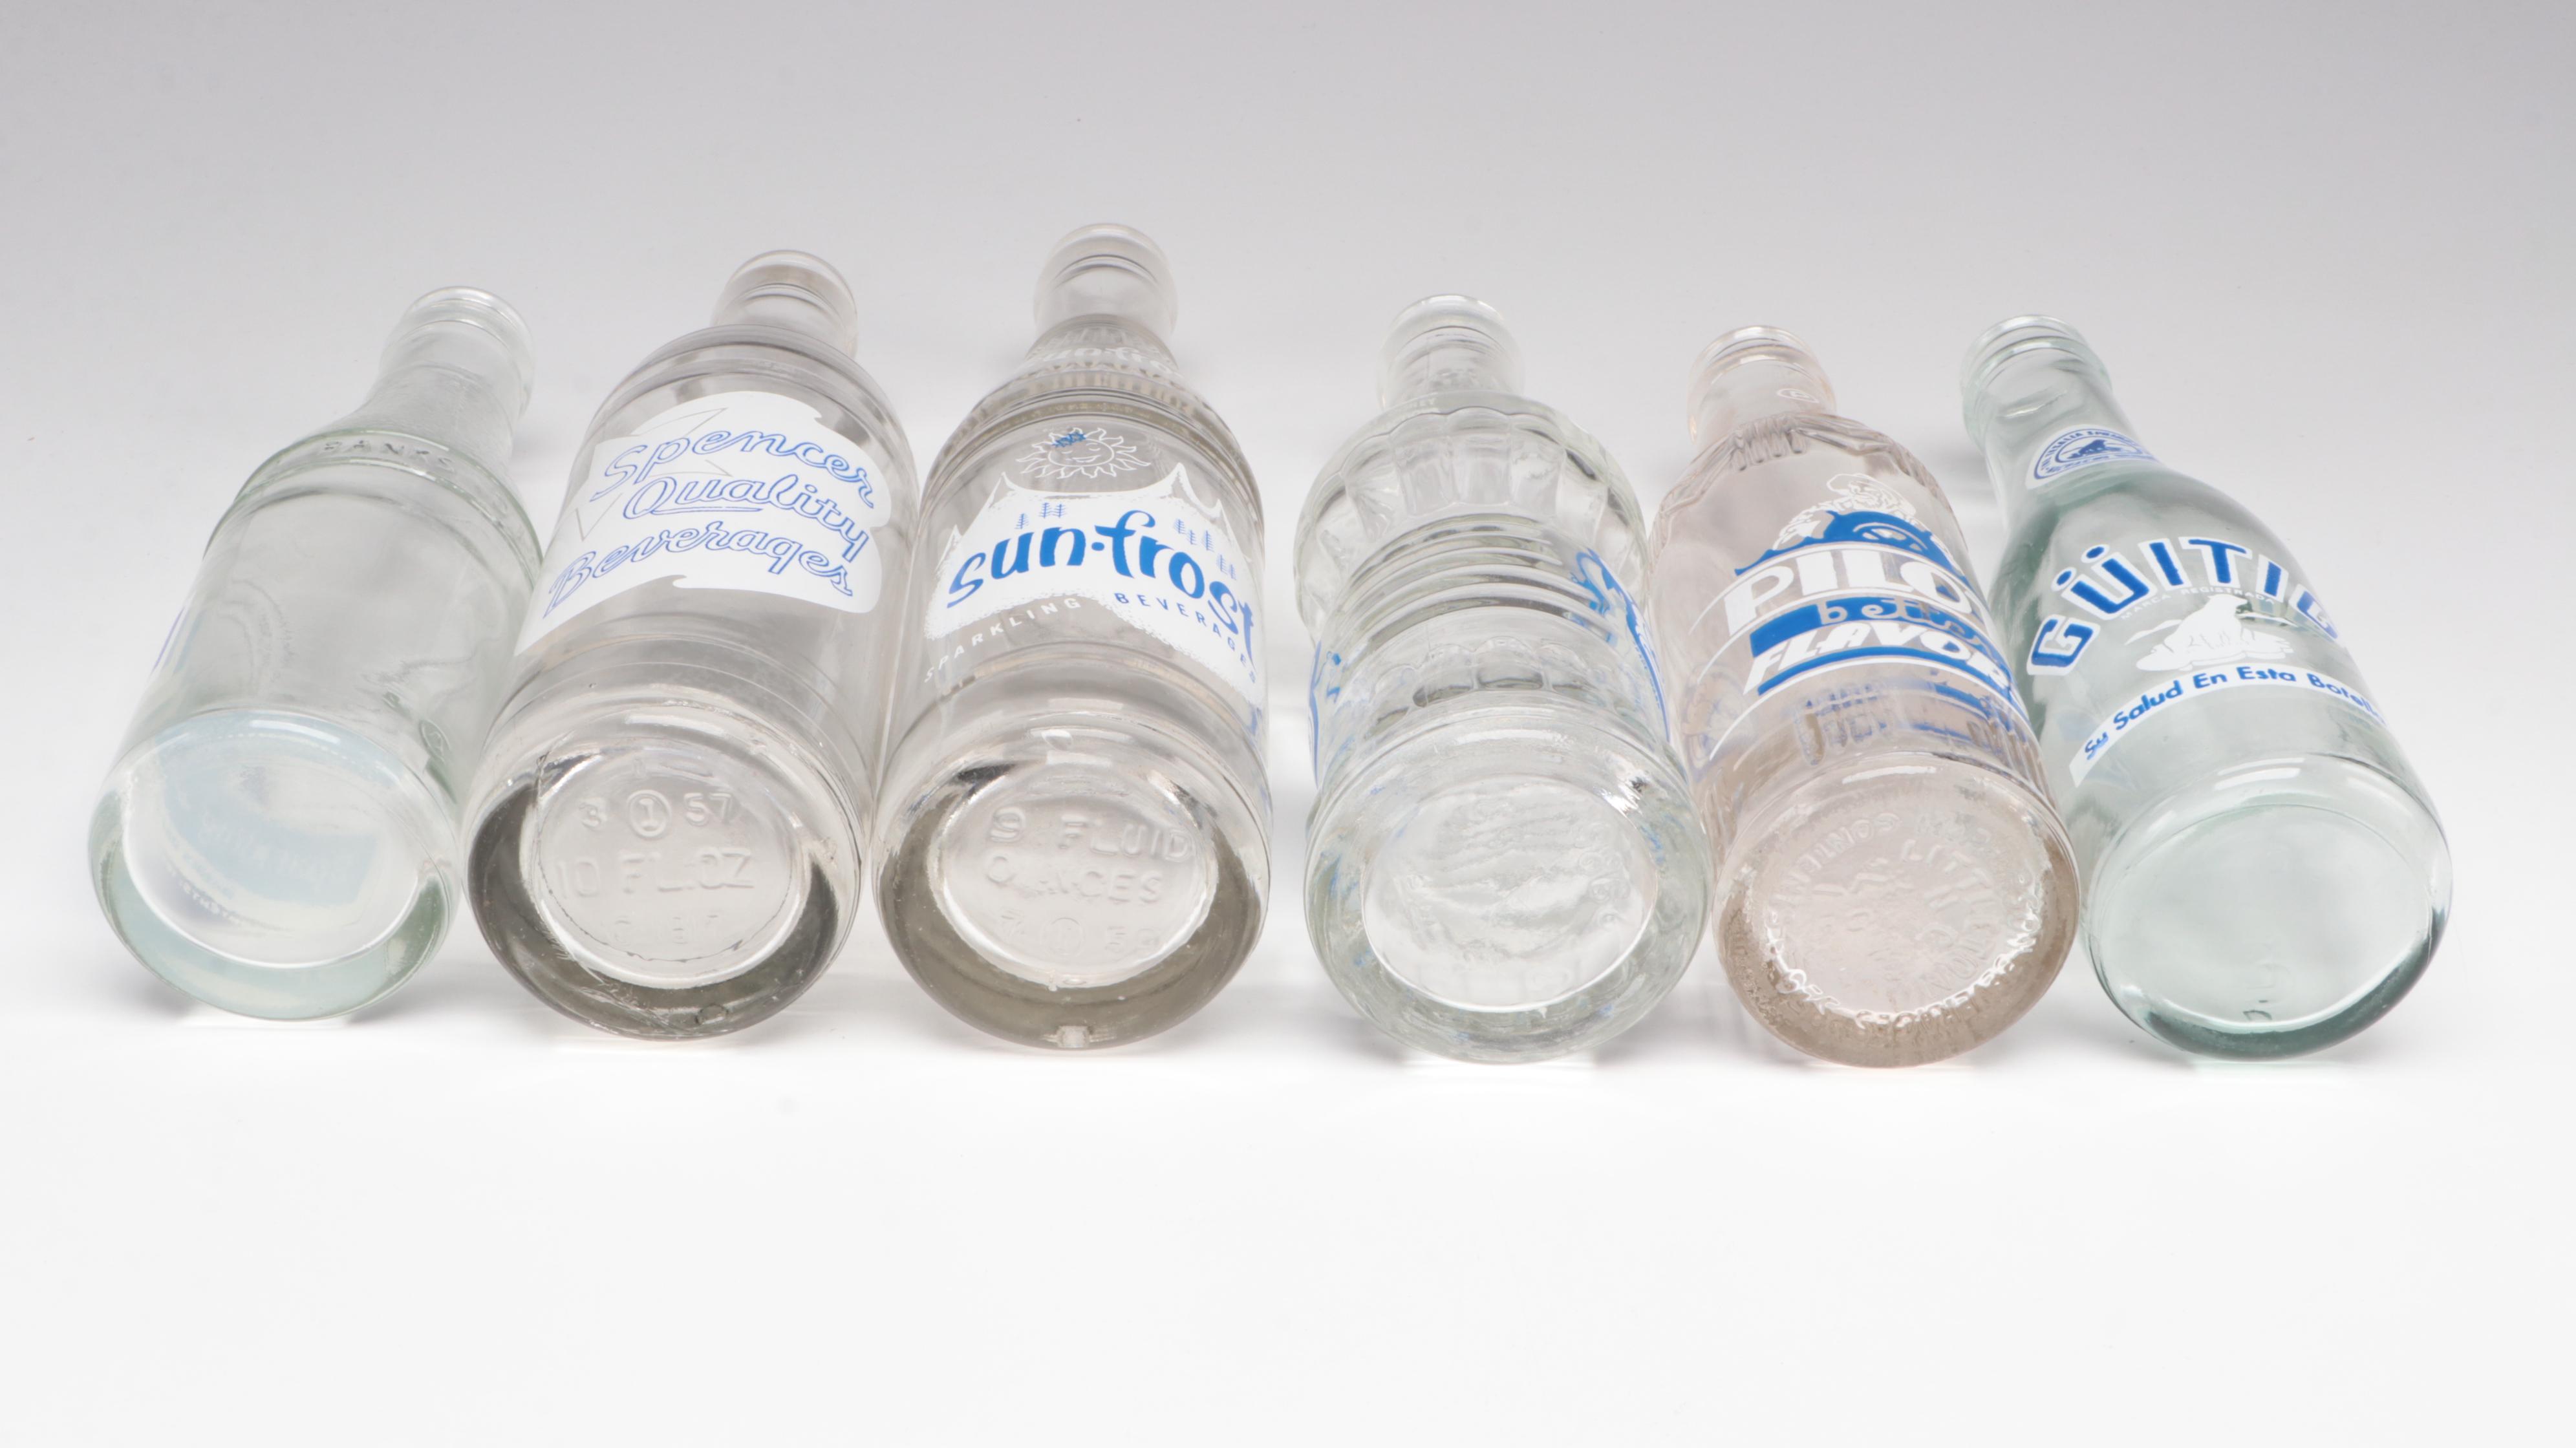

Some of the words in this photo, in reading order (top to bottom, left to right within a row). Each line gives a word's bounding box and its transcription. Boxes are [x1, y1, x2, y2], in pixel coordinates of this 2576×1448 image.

[590, 431, 874, 509] Spencer
[622, 474, 869, 562] Quality
[543, 520, 853, 619] Beverages
[2120, 593, 2171, 621] MARCA
[2182, 585, 2275, 605] REGISTRADA
[924, 596, 1082, 683] SPARKLING
[2085, 732, 2109, 760] Su
[2113, 679, 2190, 730] Salud
[2193, 672, 2228, 689] En
[2237, 666, 2297, 682] Esta
[683, 791, 738, 827] 57
[1058, 813, 1198, 862] FLUID
[555, 858, 601, 899] 10
